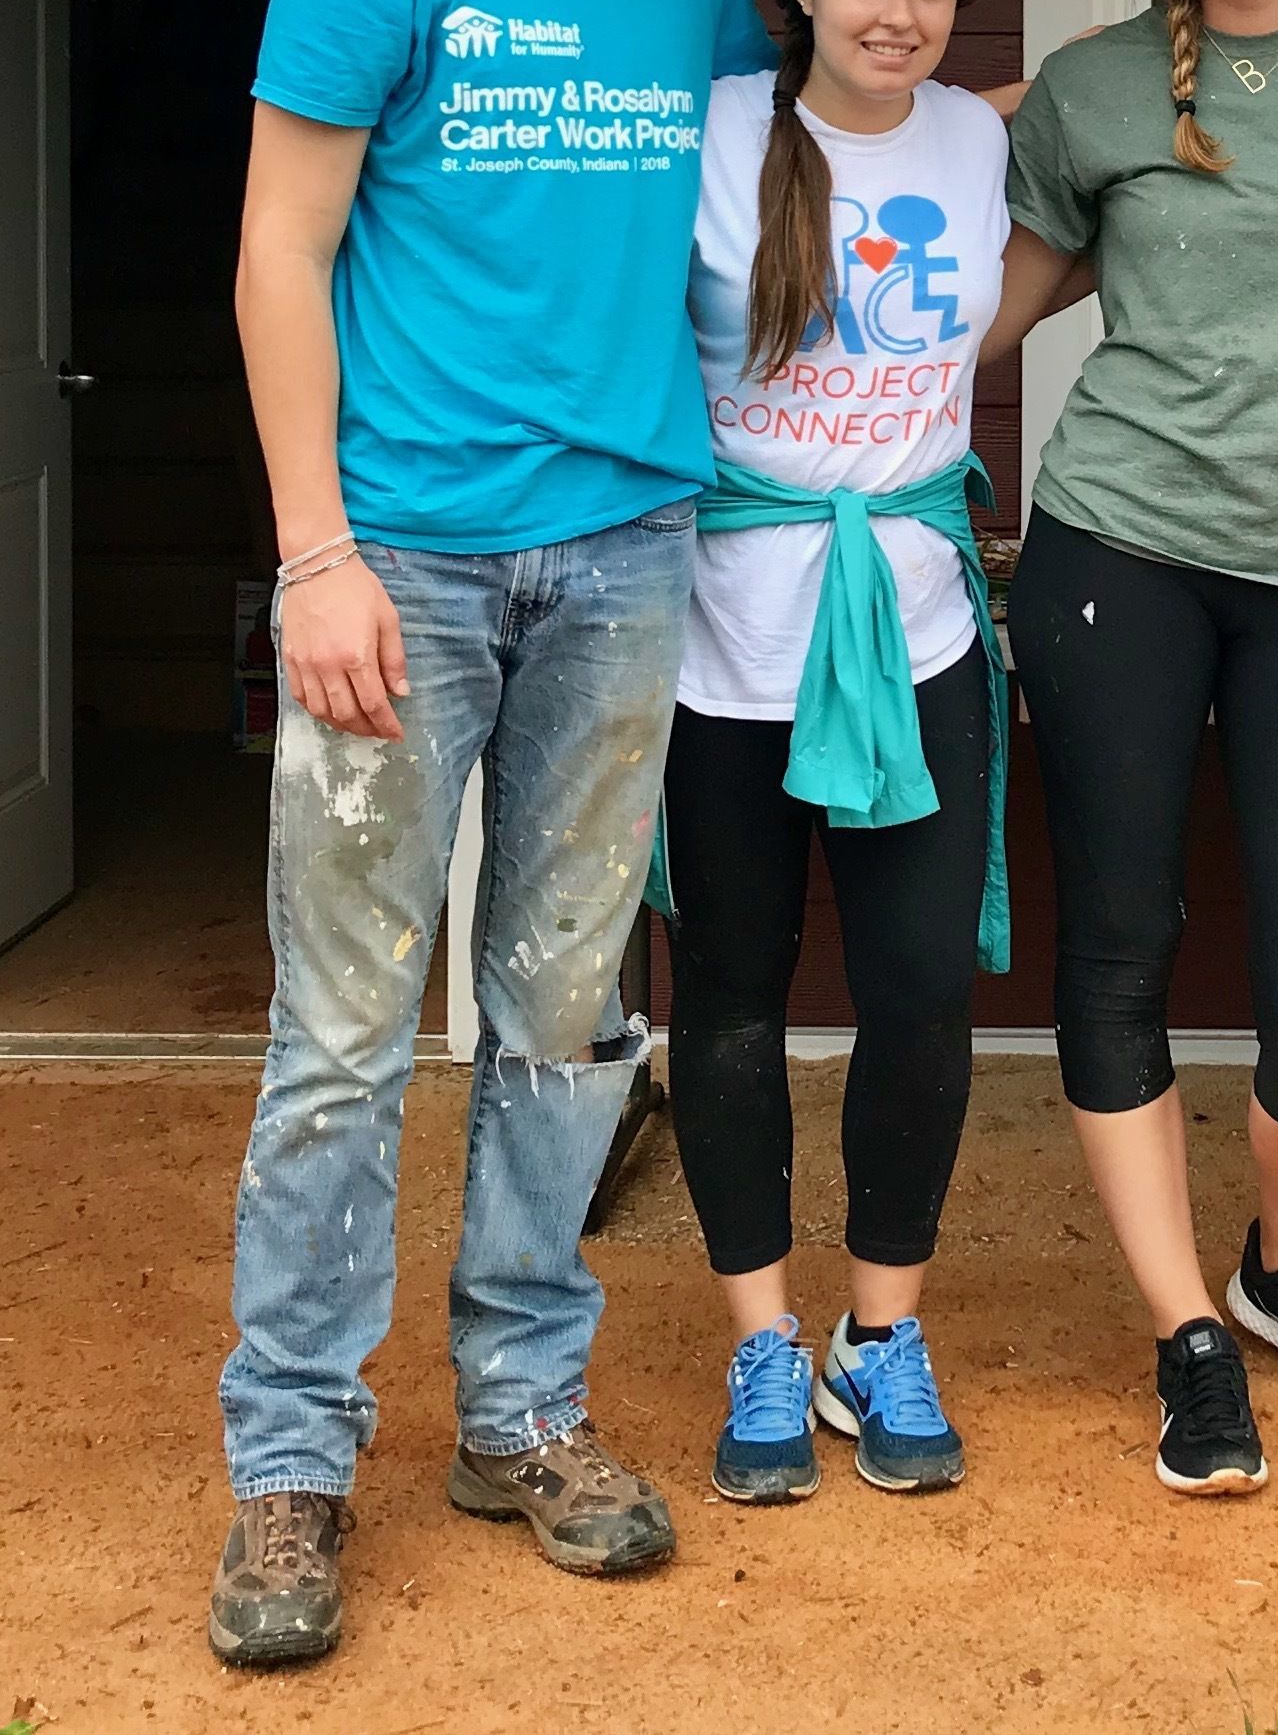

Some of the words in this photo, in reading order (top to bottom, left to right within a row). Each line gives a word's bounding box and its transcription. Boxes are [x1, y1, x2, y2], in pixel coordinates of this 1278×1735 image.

[507, 18, 581, 44] Habitat
[511, 42, 528, 56] for
[531, 42, 582, 61] Humanity
[439, 81, 557, 117] Jimmy
[561, 79, 581, 112] &
[583, 80, 694, 119] Rosalynn
[440, 118, 552, 152] Carter
[555, 115, 634, 151] Work
[440, 156, 463, 173] St.
[465, 156, 525, 174] Joseph
[526, 155, 581, 175] County,
[582, 156, 630, 172] Indiana
[641, 156, 672, 171] 2018
[762, 360, 961, 400] PROJECT
